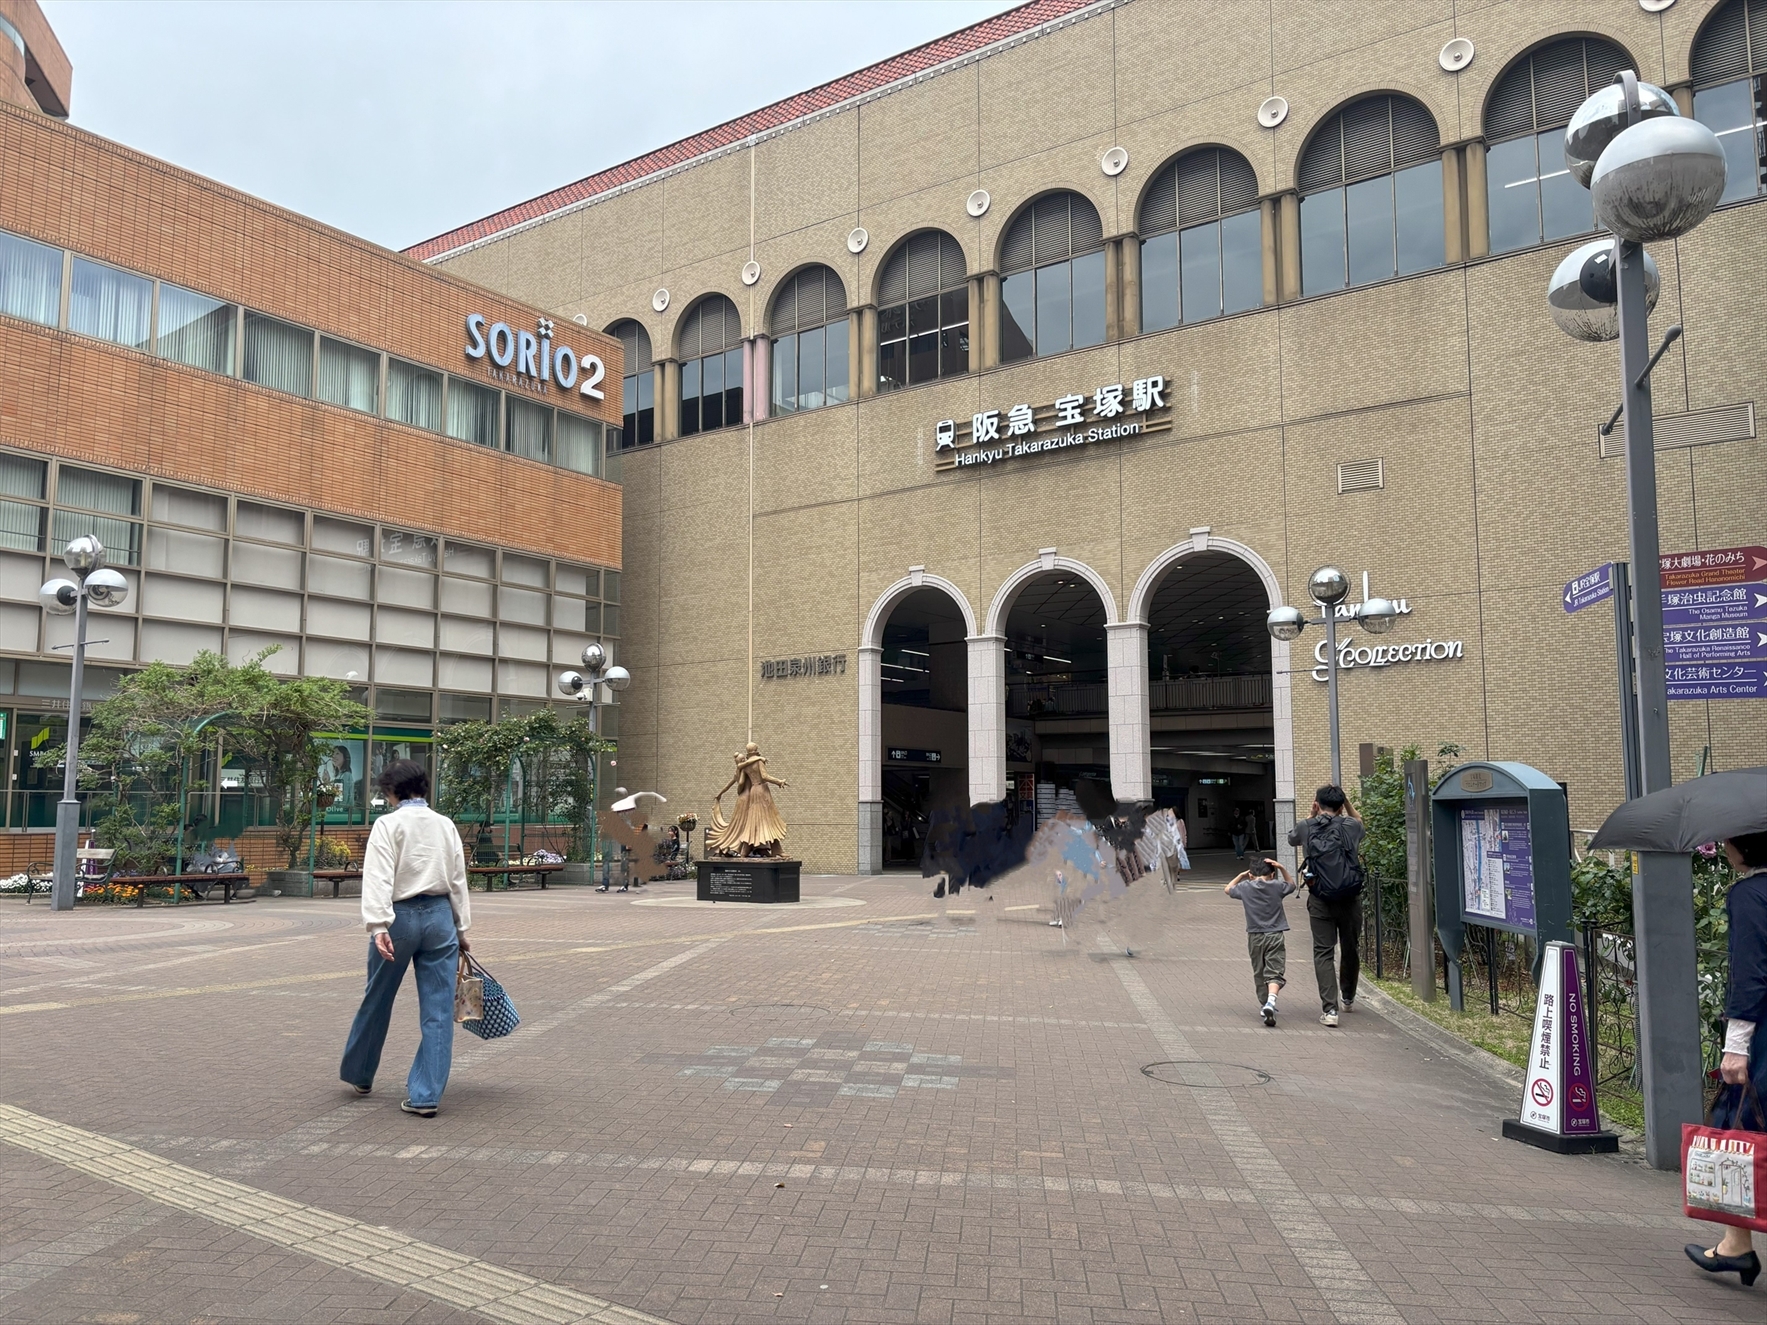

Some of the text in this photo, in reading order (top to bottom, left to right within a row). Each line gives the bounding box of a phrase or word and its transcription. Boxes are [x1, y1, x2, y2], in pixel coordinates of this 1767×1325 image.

[487, 366, 547, 394] TAKARAZUKA
[972, 375, 1165, 444] 阪急 宝塚駅
[955, 422, 1139, 466] Hankyu Takarazuka Station
[1659, 551, 1745, 570] 塚大劇場・花のみち
[1665, 572, 1699, 580] Takarazuka
[1722, 611, 1748, 619] Museum
[1675, 645, 1710, 653] Takarazuka
[761, 653, 847, 678] 池田泉州銀行
[1665, 666, 1757, 680] 文化芸術センター
[1666, 684, 1758, 695] akarazuka Arts Center
[1538, 993, 1555, 1070] 路上喫煙禁止
[1569, 992, 1581, 1076] NO SMOKING
